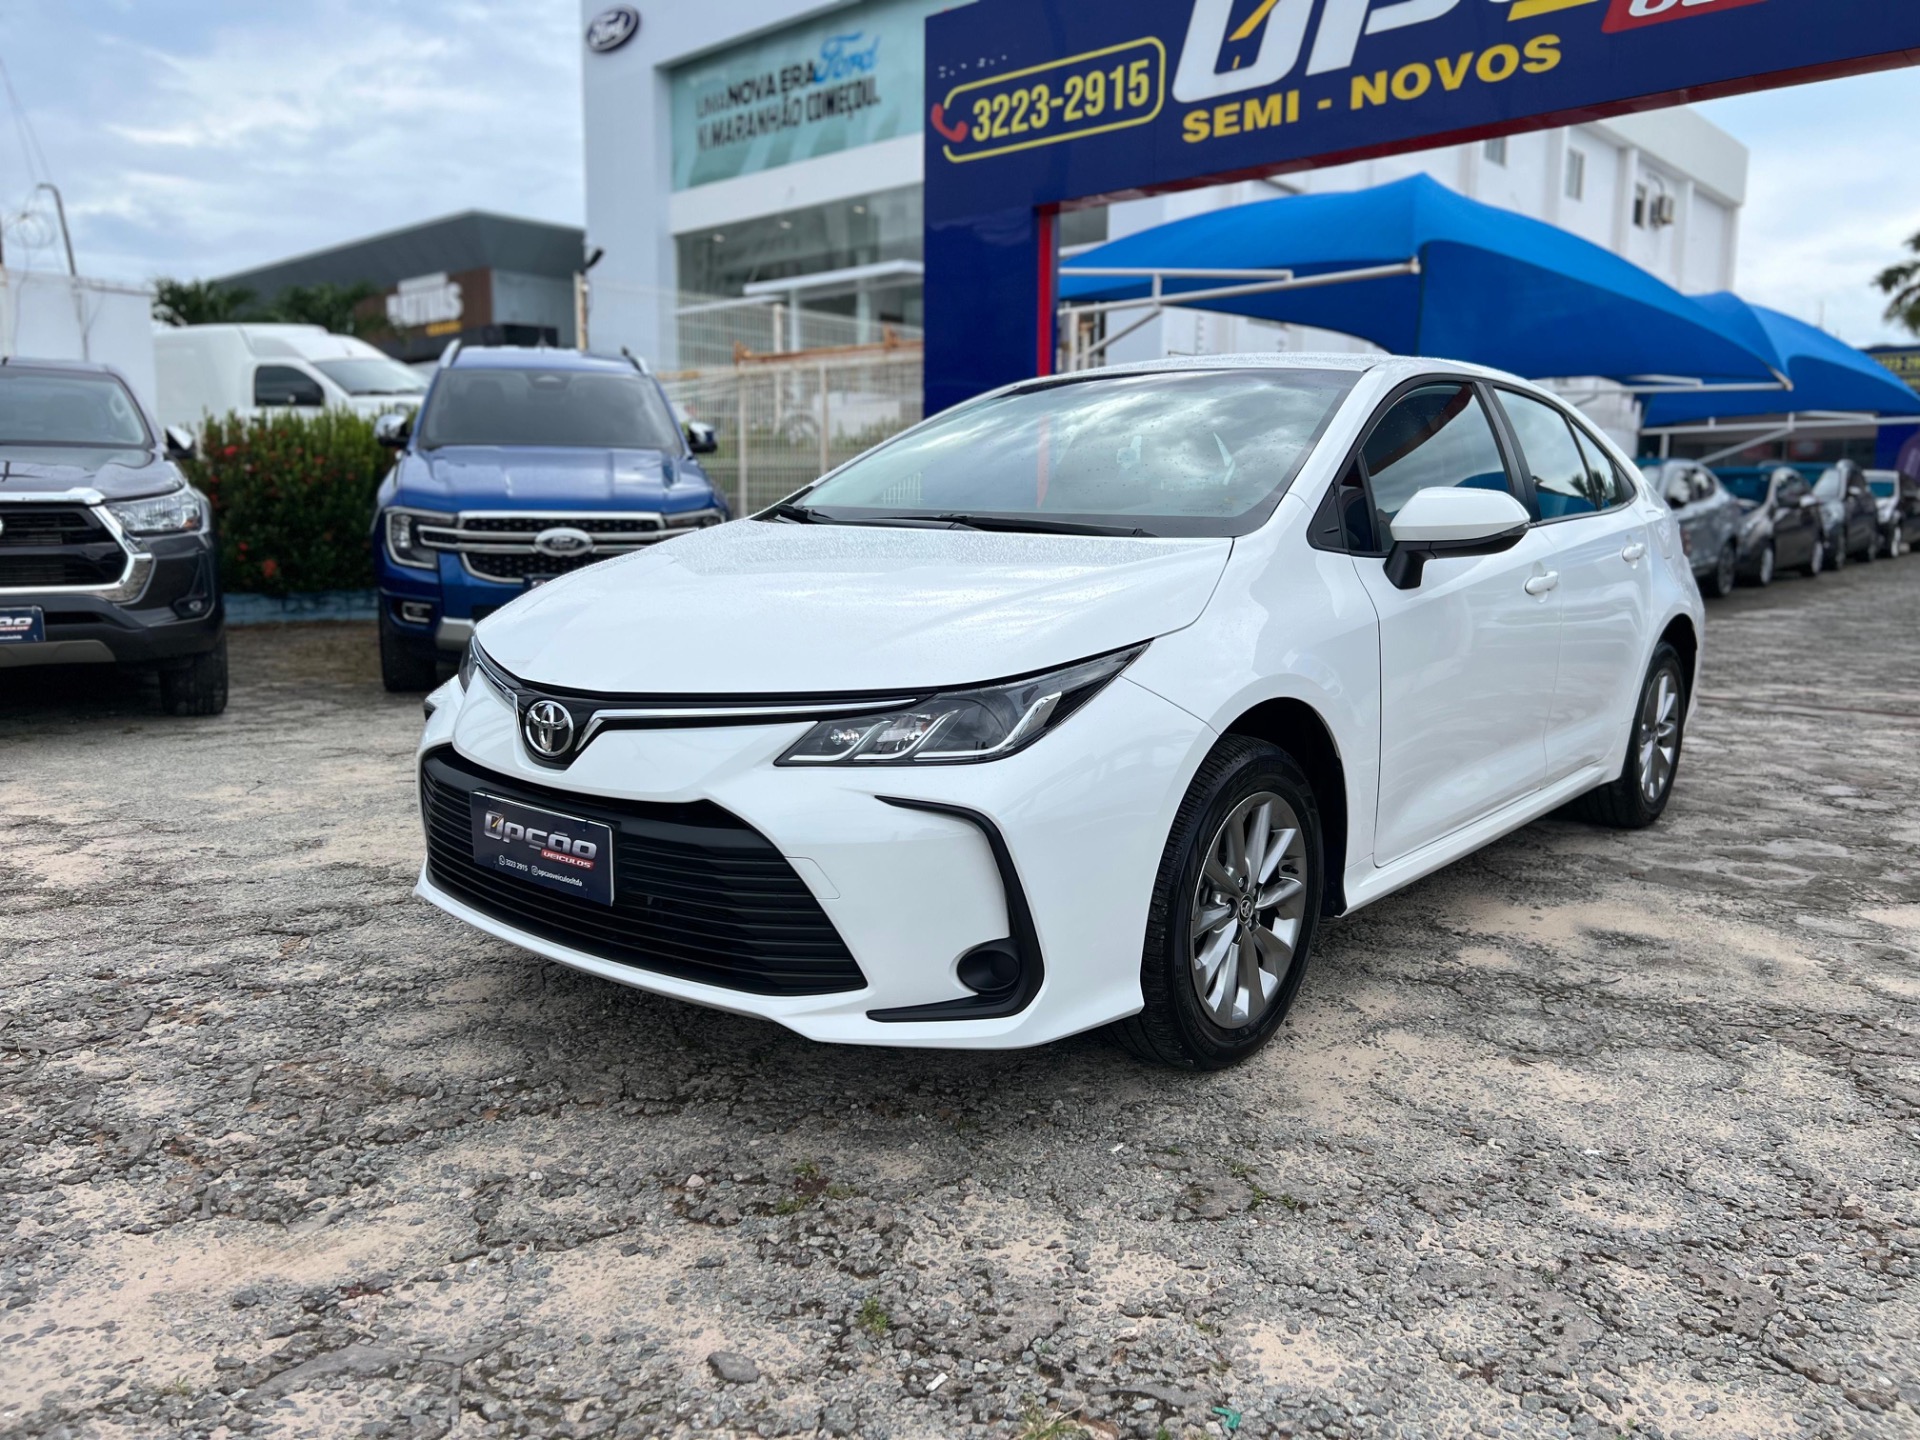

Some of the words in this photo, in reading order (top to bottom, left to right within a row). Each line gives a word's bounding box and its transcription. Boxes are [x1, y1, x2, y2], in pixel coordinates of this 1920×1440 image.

[727, 71, 776, 106] NOVA
[780, 60, 816, 92] ERA
[814, 32, 881, 84] Ford
[972, 58, 1150, 142] 3223-2915
[1182, 89, 1299, 143] SEMI
[1350, 34, 1562, 110] NOVOS
[505, 858, 517, 869] 3223
[516, 862, 529, 872] 2915
